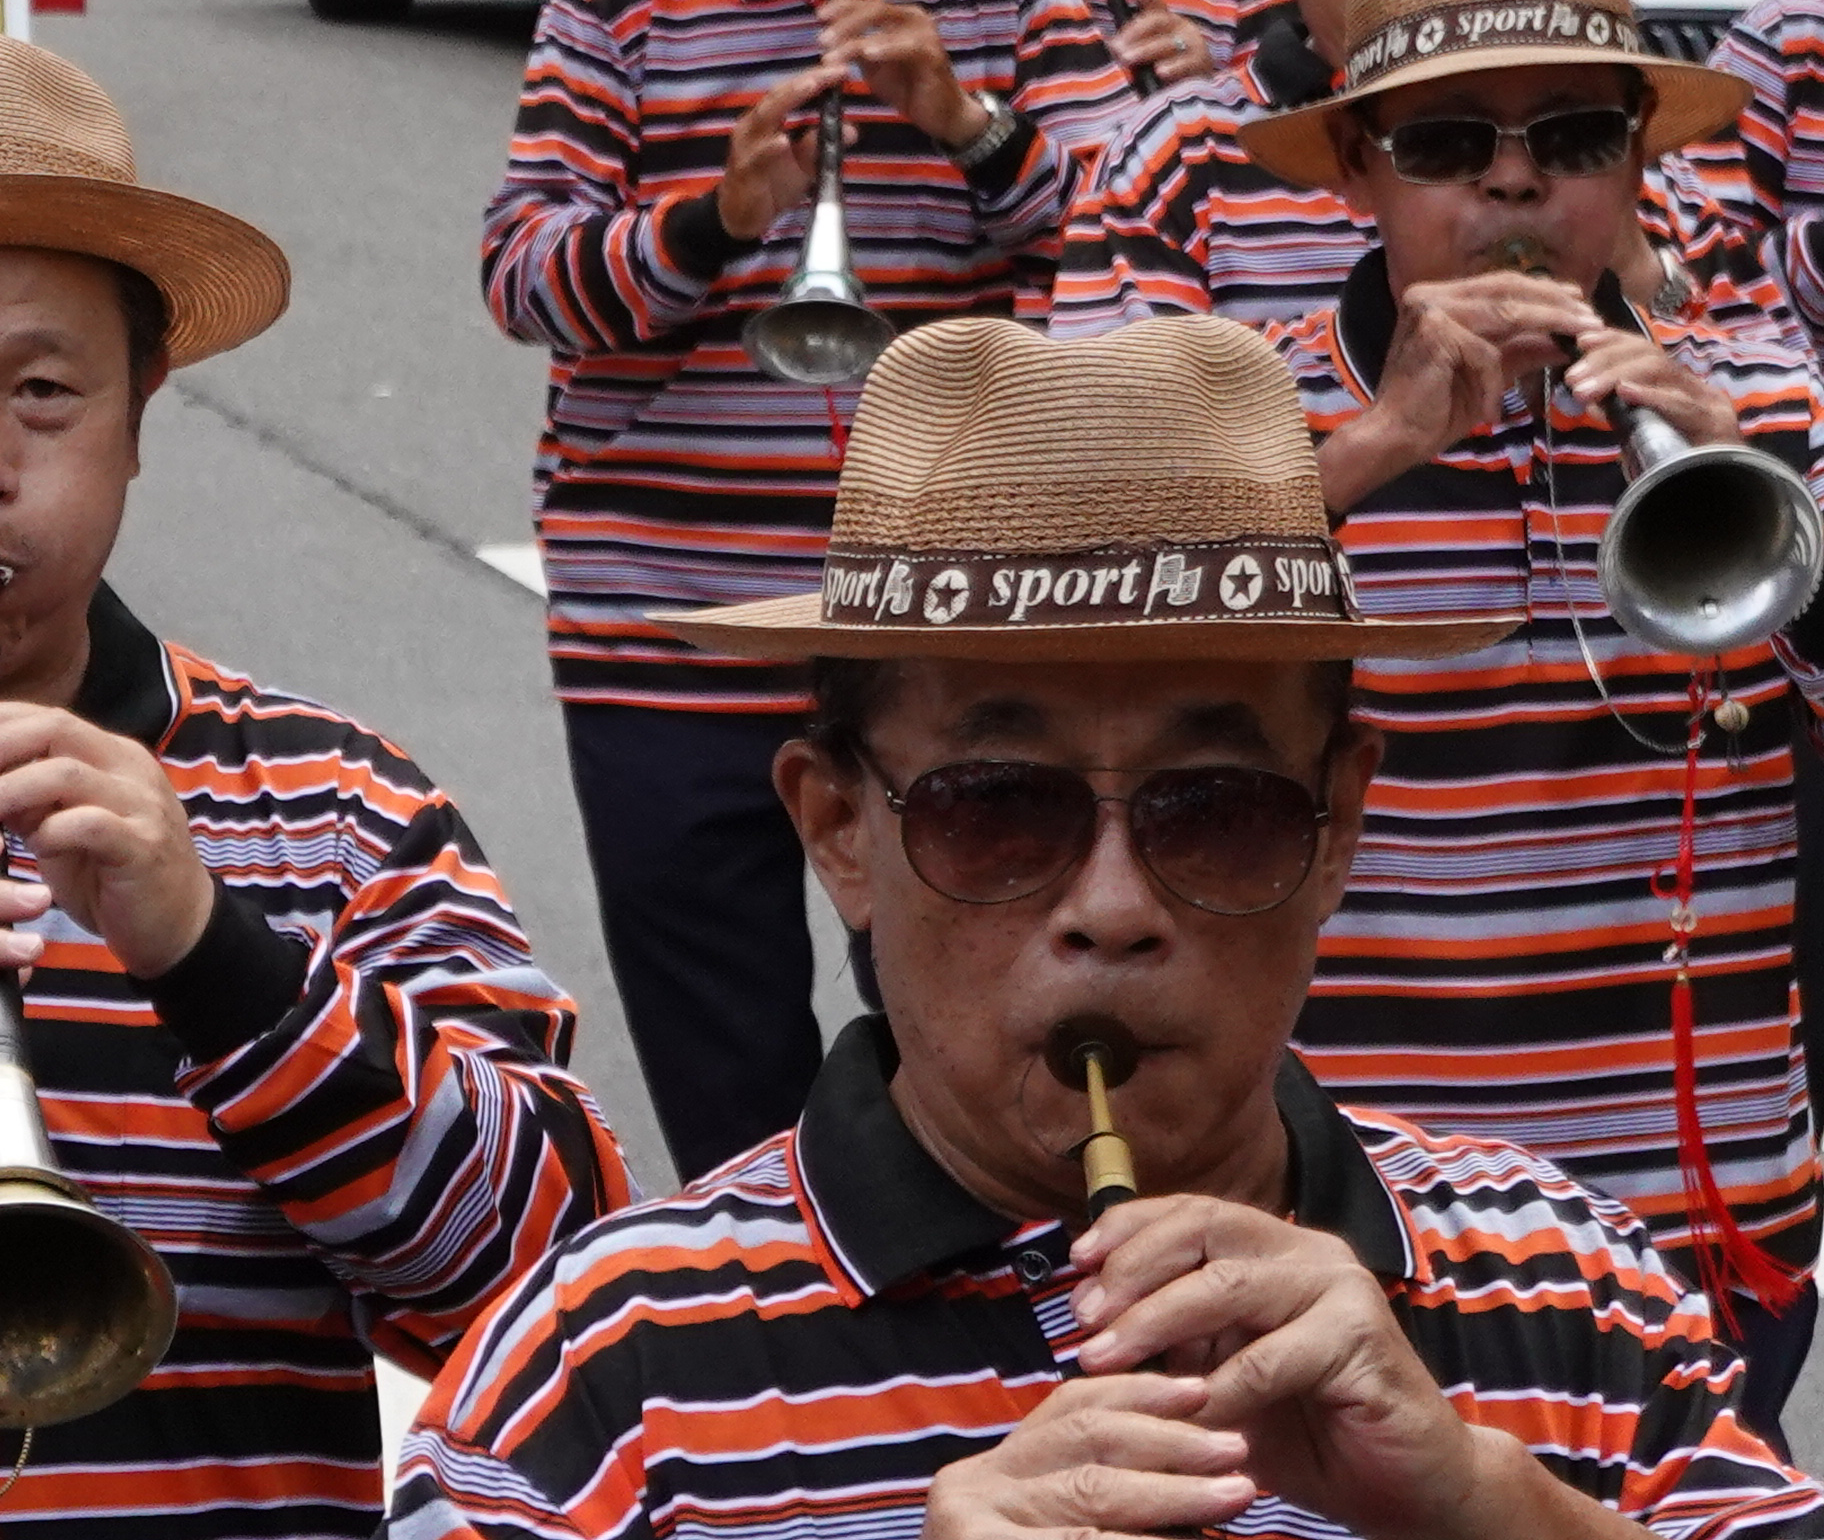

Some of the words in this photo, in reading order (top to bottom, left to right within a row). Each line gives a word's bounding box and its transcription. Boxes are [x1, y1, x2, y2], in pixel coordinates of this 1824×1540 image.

[1456, 2, 1549, 43] sport
[824, 558, 885, 618] sport
[987, 559, 1143, 622] sport
